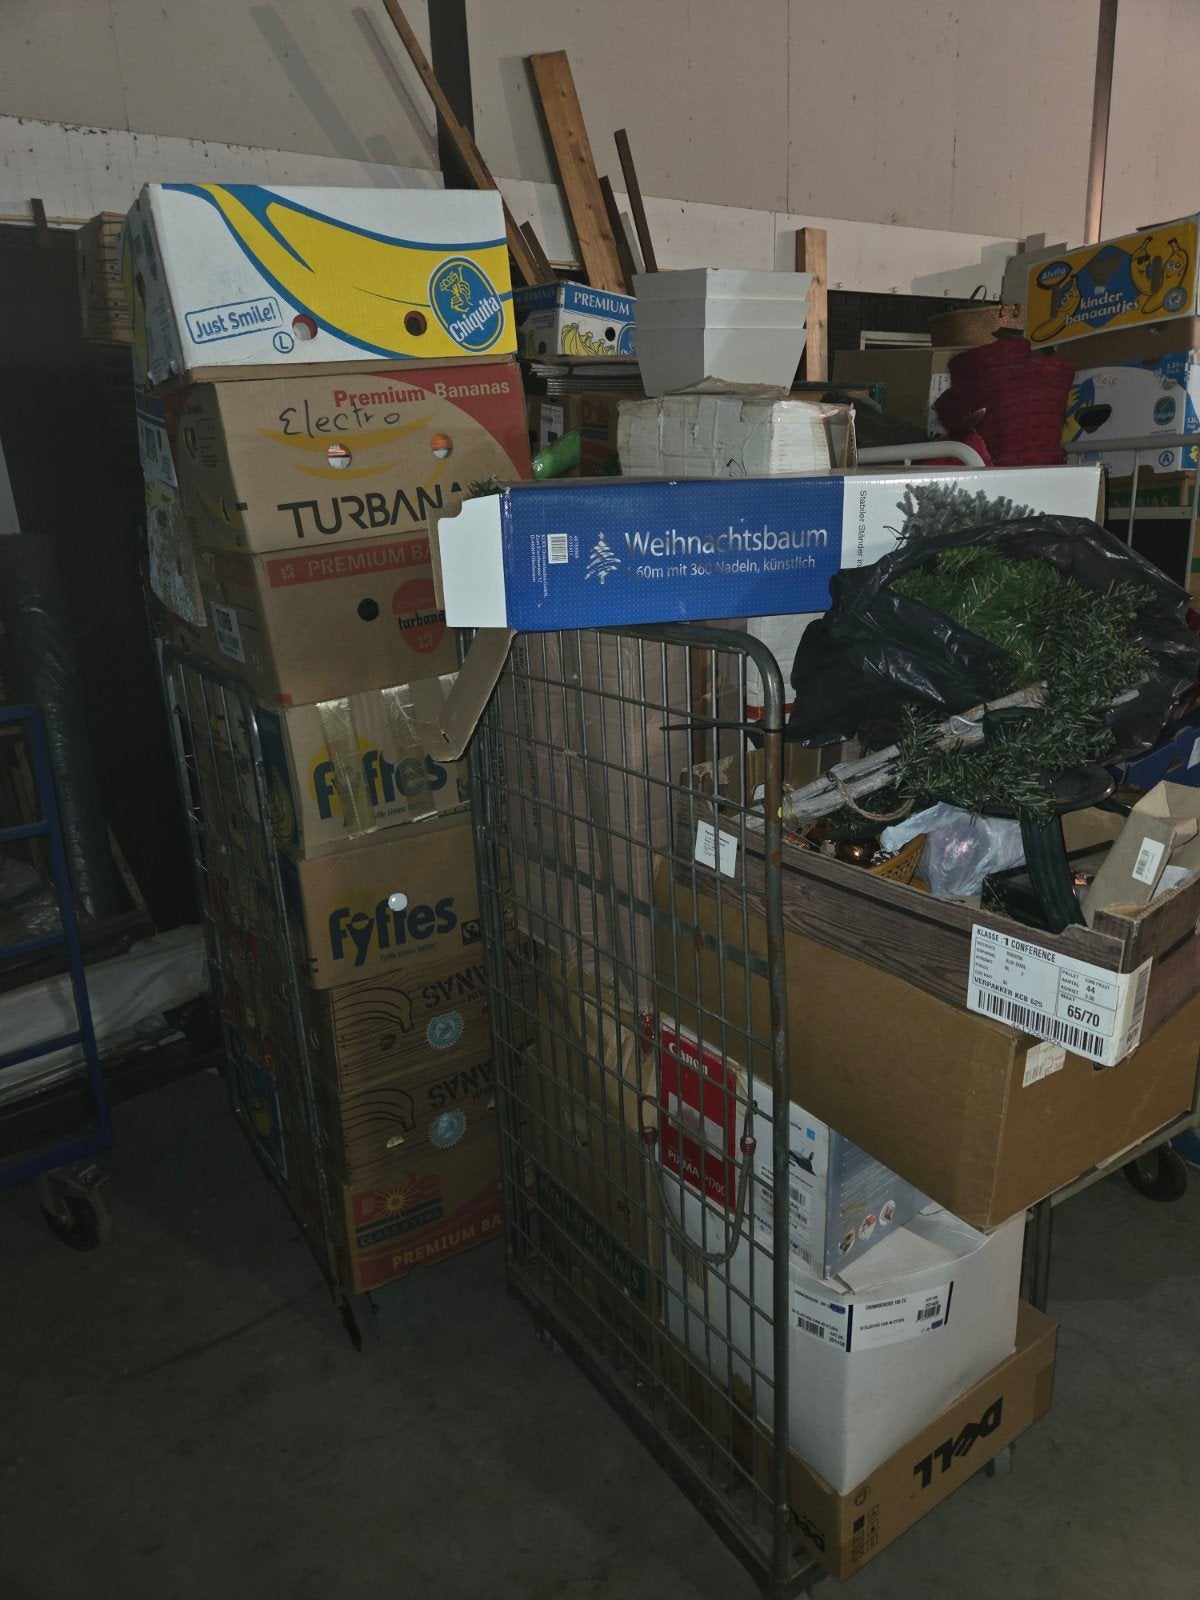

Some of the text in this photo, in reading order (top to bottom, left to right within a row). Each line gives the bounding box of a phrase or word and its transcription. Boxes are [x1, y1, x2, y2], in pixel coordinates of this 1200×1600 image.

[574, 290, 630, 316] PREMIUM
[1064, 300, 1140, 326] banaantjes
[1080, 291, 1124, 311] kinder
[195, 302, 277, 339] Just Smile!
[449, 296, 501, 344] Chiquita
[278, 335, 290, 350] L
[333, 380, 510, 409] Premium Bananas
[278, 399, 401, 439] Electro
[624, 524, 829, 557] Weihnachtsbaum
[307, 547, 407, 577] PREMIUM
[667, 562, 688, 578] mit
[716, 558, 761, 575] Nadeln,
[763, 555, 817, 573] künstlich
[313, 750, 448, 824] fffes
[328, 897, 458, 967] fyffes
[976, 928, 999, 942] KLASSE
[1011, 939, 1056, 963] CONFERENCE
[974, 976, 1013, 997] VERPAKKER
[1066, 1004, 1100, 1028] 65/70
[667, 1042, 709, 1077] Canon
[360, 1224, 401, 1247] CLASS
[391, 1224, 477, 1270] PREMIUM
[912, 1396, 1004, 1490] DELL
